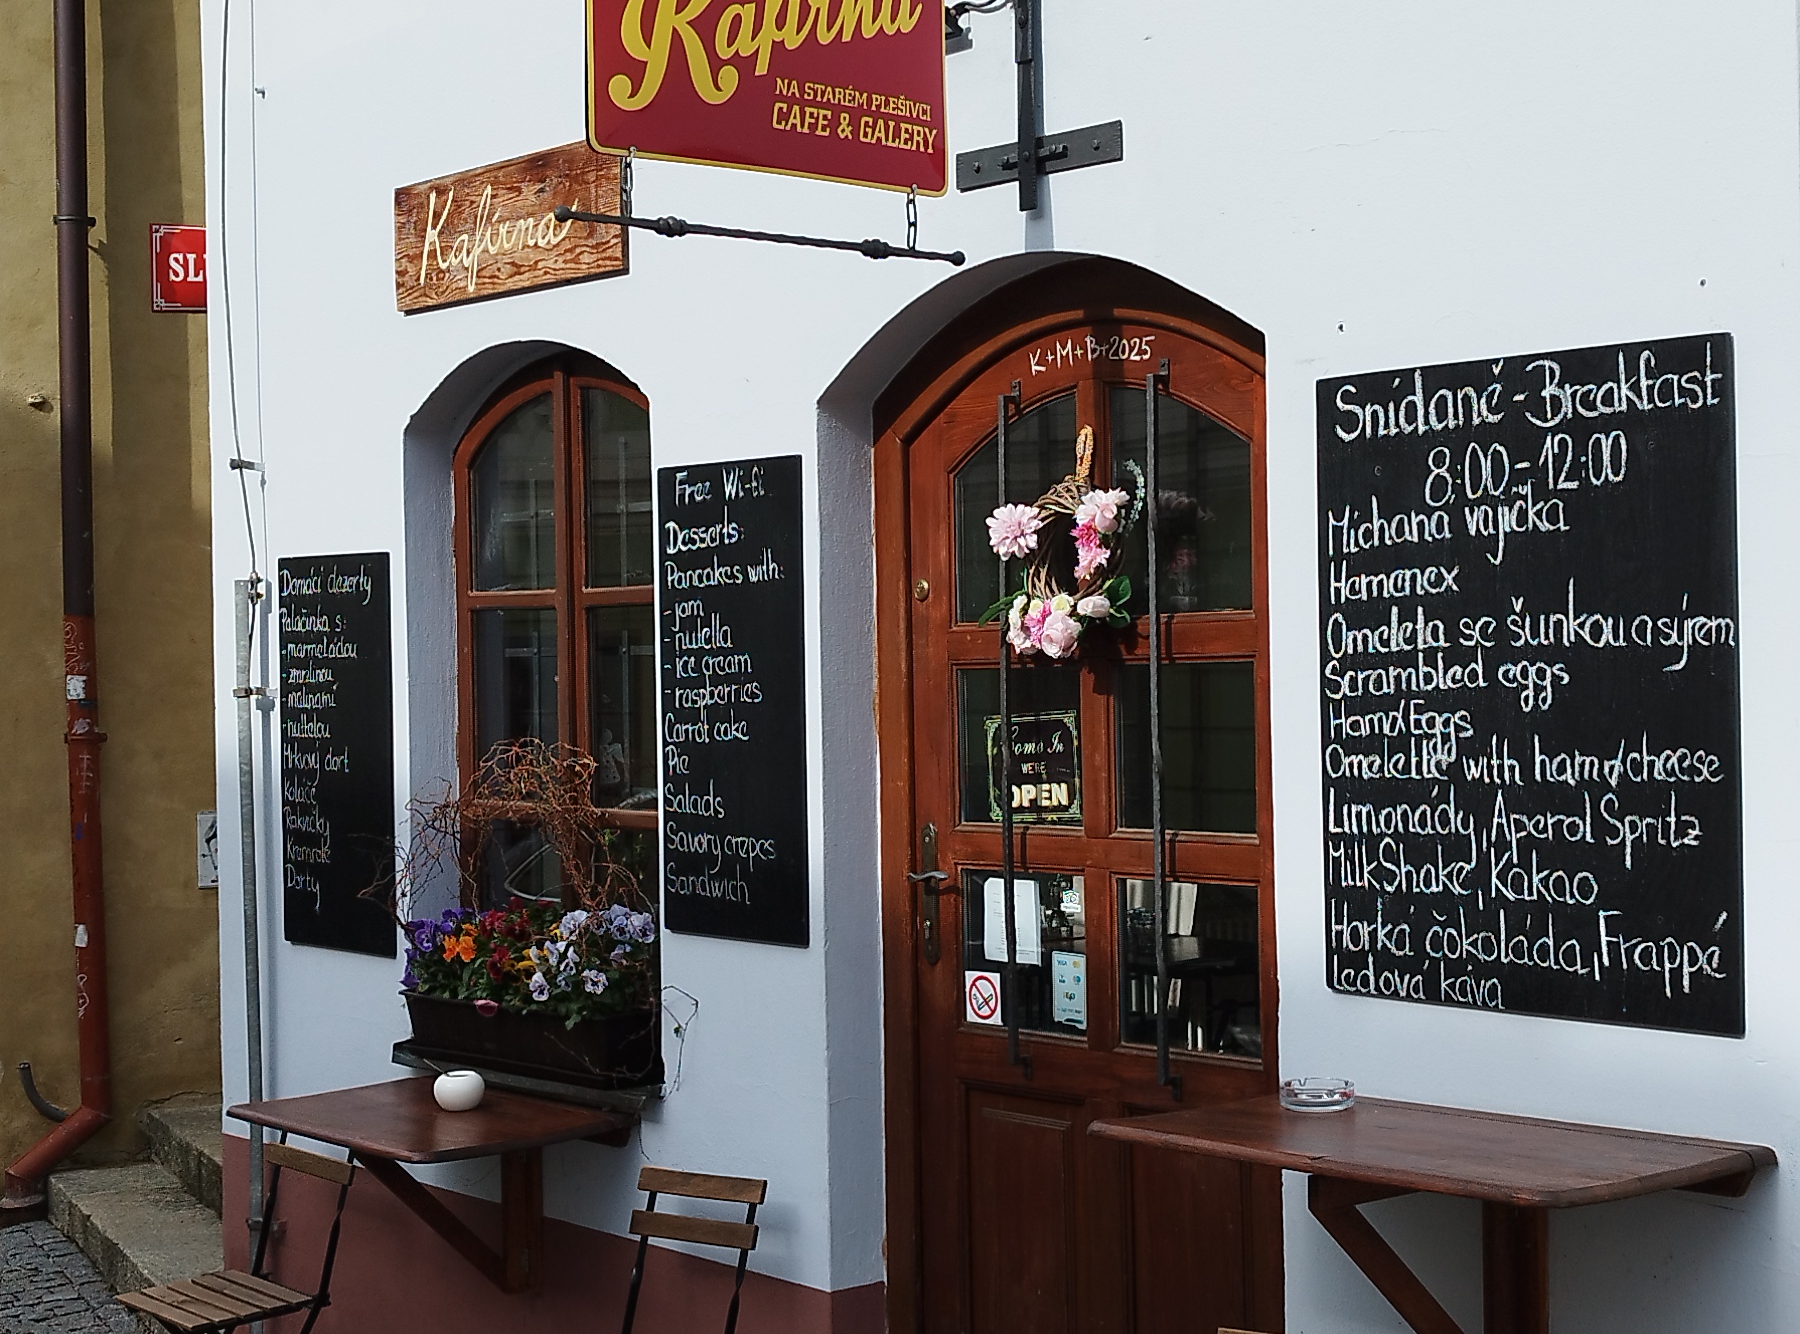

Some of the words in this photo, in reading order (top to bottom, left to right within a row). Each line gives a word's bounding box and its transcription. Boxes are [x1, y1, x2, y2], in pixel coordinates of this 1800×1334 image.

[774, 77, 800, 98] NA
[803, 81, 868, 110] STARÉM
[871, 92, 932, 122] PLEŠIVCI
[772, 102, 832, 136] CAFE
[837, 112, 854, 140] &
[859, 116, 938, 154] GALERY
[420, 184, 578, 292] Kafírna
[168, 253, 207, 282] SL
[1029, 333, 1155, 377] K+M+B+2025
[1335, 358, 1505, 442] Snídaně
[1525, 342, 1723, 427] Breakfast
[674, 469, 713, 507] Free
[665, 505, 745, 555] Desserts:
[327, 563, 372, 605] dezerty
[665, 553, 744, 590] Pancakes
[747, 546, 785, 584] with:
[1327, 605, 1453, 658] Omeleta
[1459, 616, 1497, 647] se
[701, 652, 753, 676] cream
[1324, 645, 1489, 700] Scrambled
[1498, 660, 1570, 712] eggs
[664, 710, 710, 744] Carrot
[713, 708, 750, 742] cake
[325, 746, 350, 773] dort
[664, 745, 690, 776] Pie
[1325, 736, 1449, 780] Omelette
[1463, 733, 1524, 786] with
[664, 778, 725, 818] Salads
[666, 821, 722, 874] Savory
[724, 835, 777, 873] crepes
[1491, 788, 1595, 865] Aperol
[1600, 789, 1703, 870] Spritz
[285, 863, 320, 910] Dorty
[666, 862, 750, 905] Sandwich
[1491, 846, 1599, 906] Kakao
[1331, 898, 1415, 957] Horká
